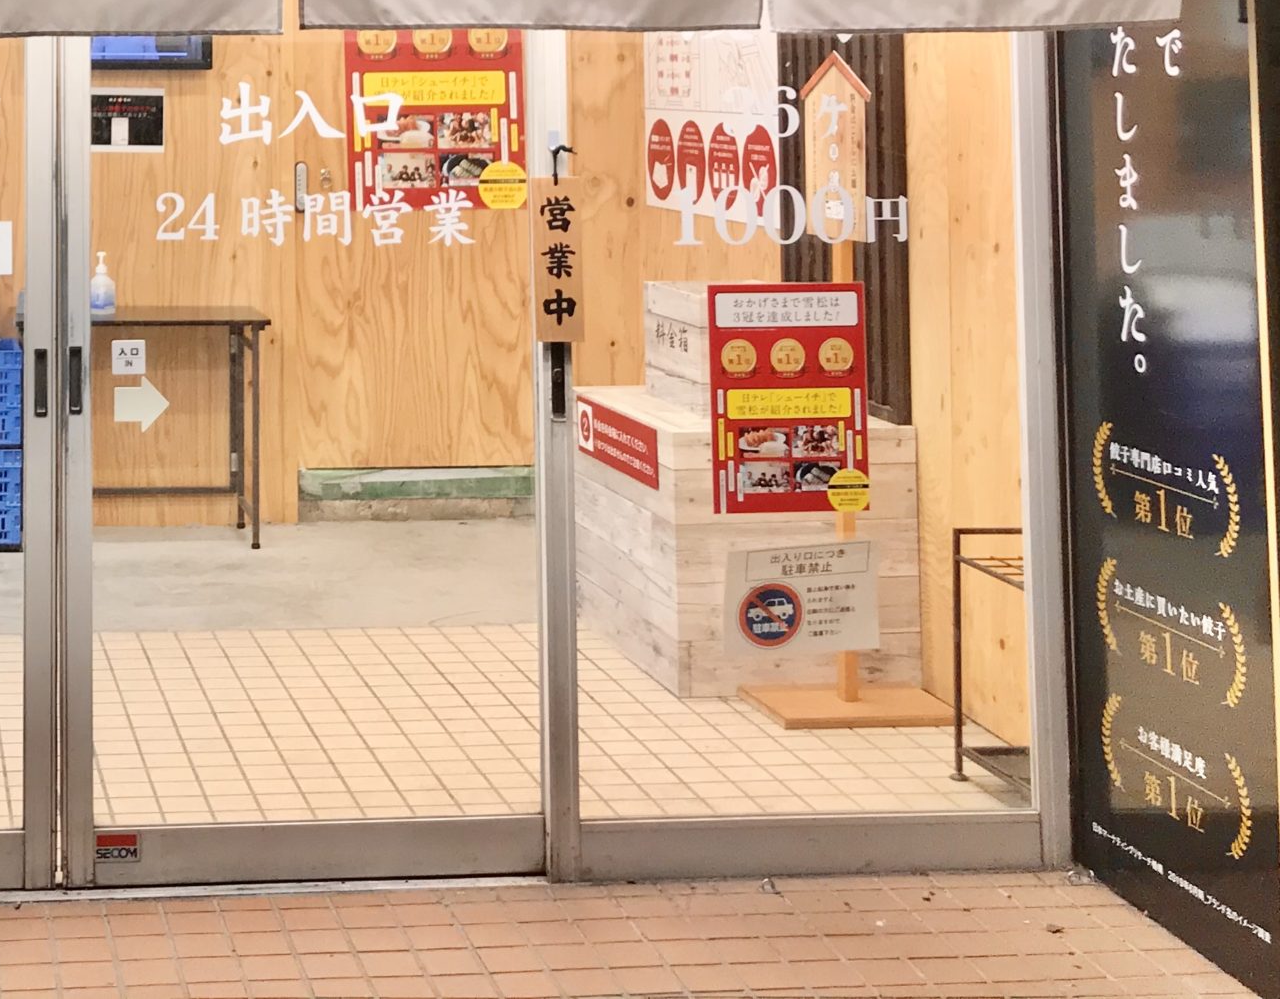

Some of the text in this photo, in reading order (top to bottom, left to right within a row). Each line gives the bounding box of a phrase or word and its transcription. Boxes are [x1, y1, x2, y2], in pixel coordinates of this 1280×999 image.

[218, 81, 406, 146] 出入口
[673, 183, 909, 245] 1000円
[1109, 25, 1148, 374] たしました。
[538, 194, 578, 326] 営業中
[1133, 488, 1195, 541] 第1位
[770, 548, 846, 565] 出入り口につき
[781, 561, 833, 576] 駐車禁止
[1138, 629, 1200, 686] 第1位
[1143, 769, 1205, 834] 第1位
[95, 848, 138, 859] SECOM
